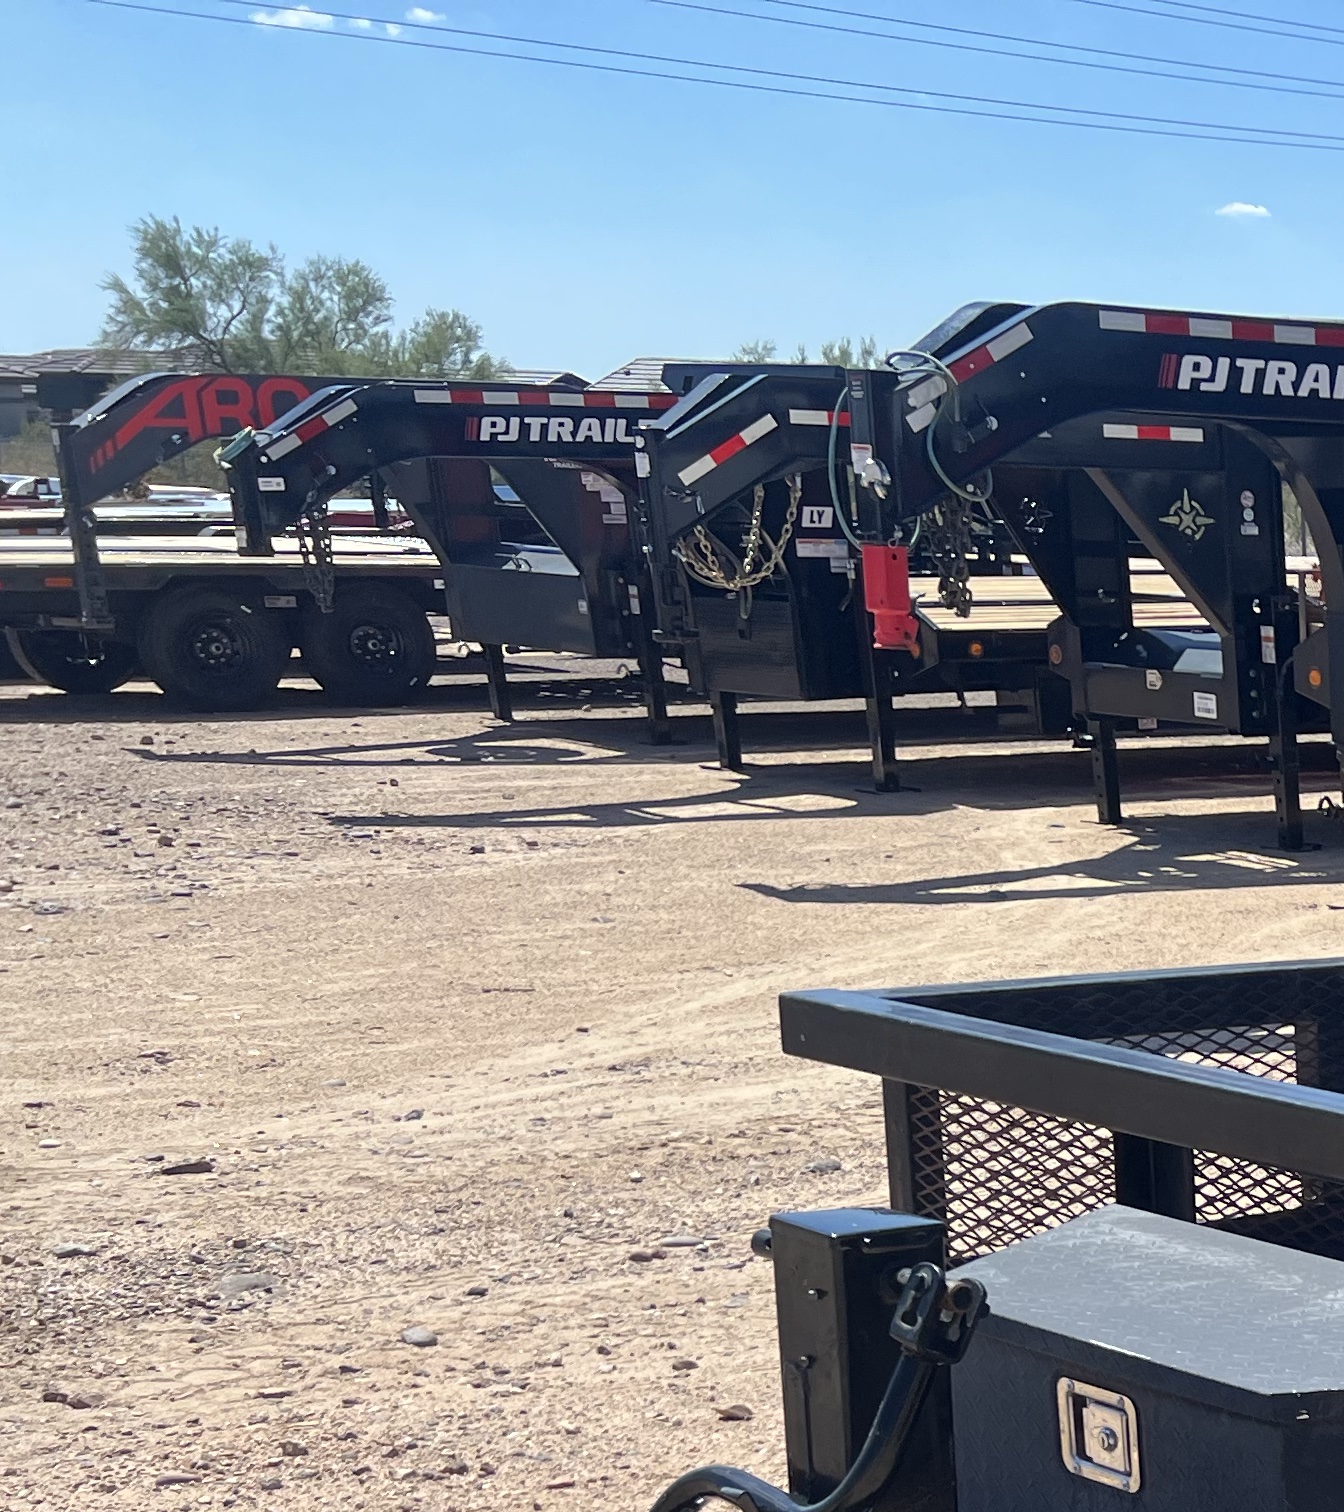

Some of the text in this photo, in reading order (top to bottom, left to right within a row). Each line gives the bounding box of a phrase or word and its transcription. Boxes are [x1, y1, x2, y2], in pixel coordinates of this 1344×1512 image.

[1177, 354, 1231, 392] PJ
[479, 416, 637, 443] PJ TRAIL
[809, 509, 826, 524] LY
